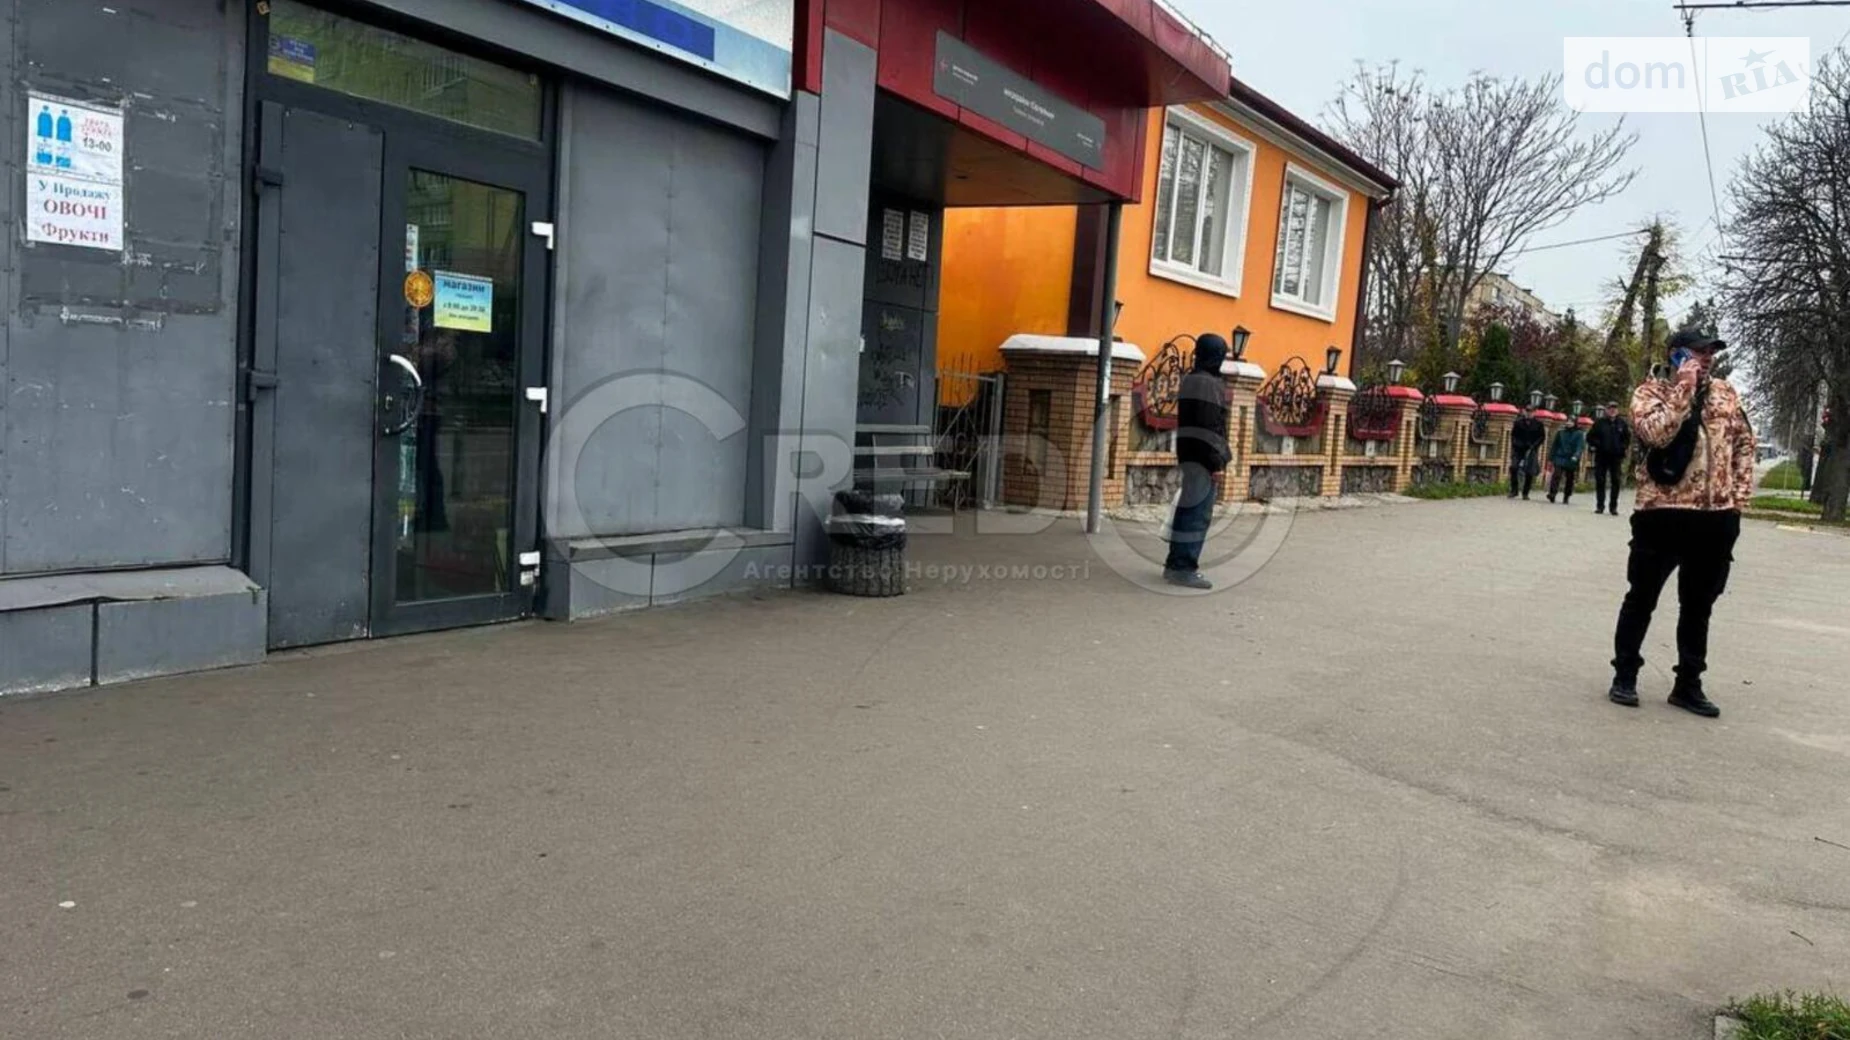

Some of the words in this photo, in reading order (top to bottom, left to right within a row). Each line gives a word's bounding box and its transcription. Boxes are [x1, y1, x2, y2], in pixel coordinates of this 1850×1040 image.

[83, 137, 112, 153] 13-00
[53, 182, 111, 201] Продажу
[43, 199, 107, 220] ОВОЧІ
[41, 222, 109, 243] Фрукти
